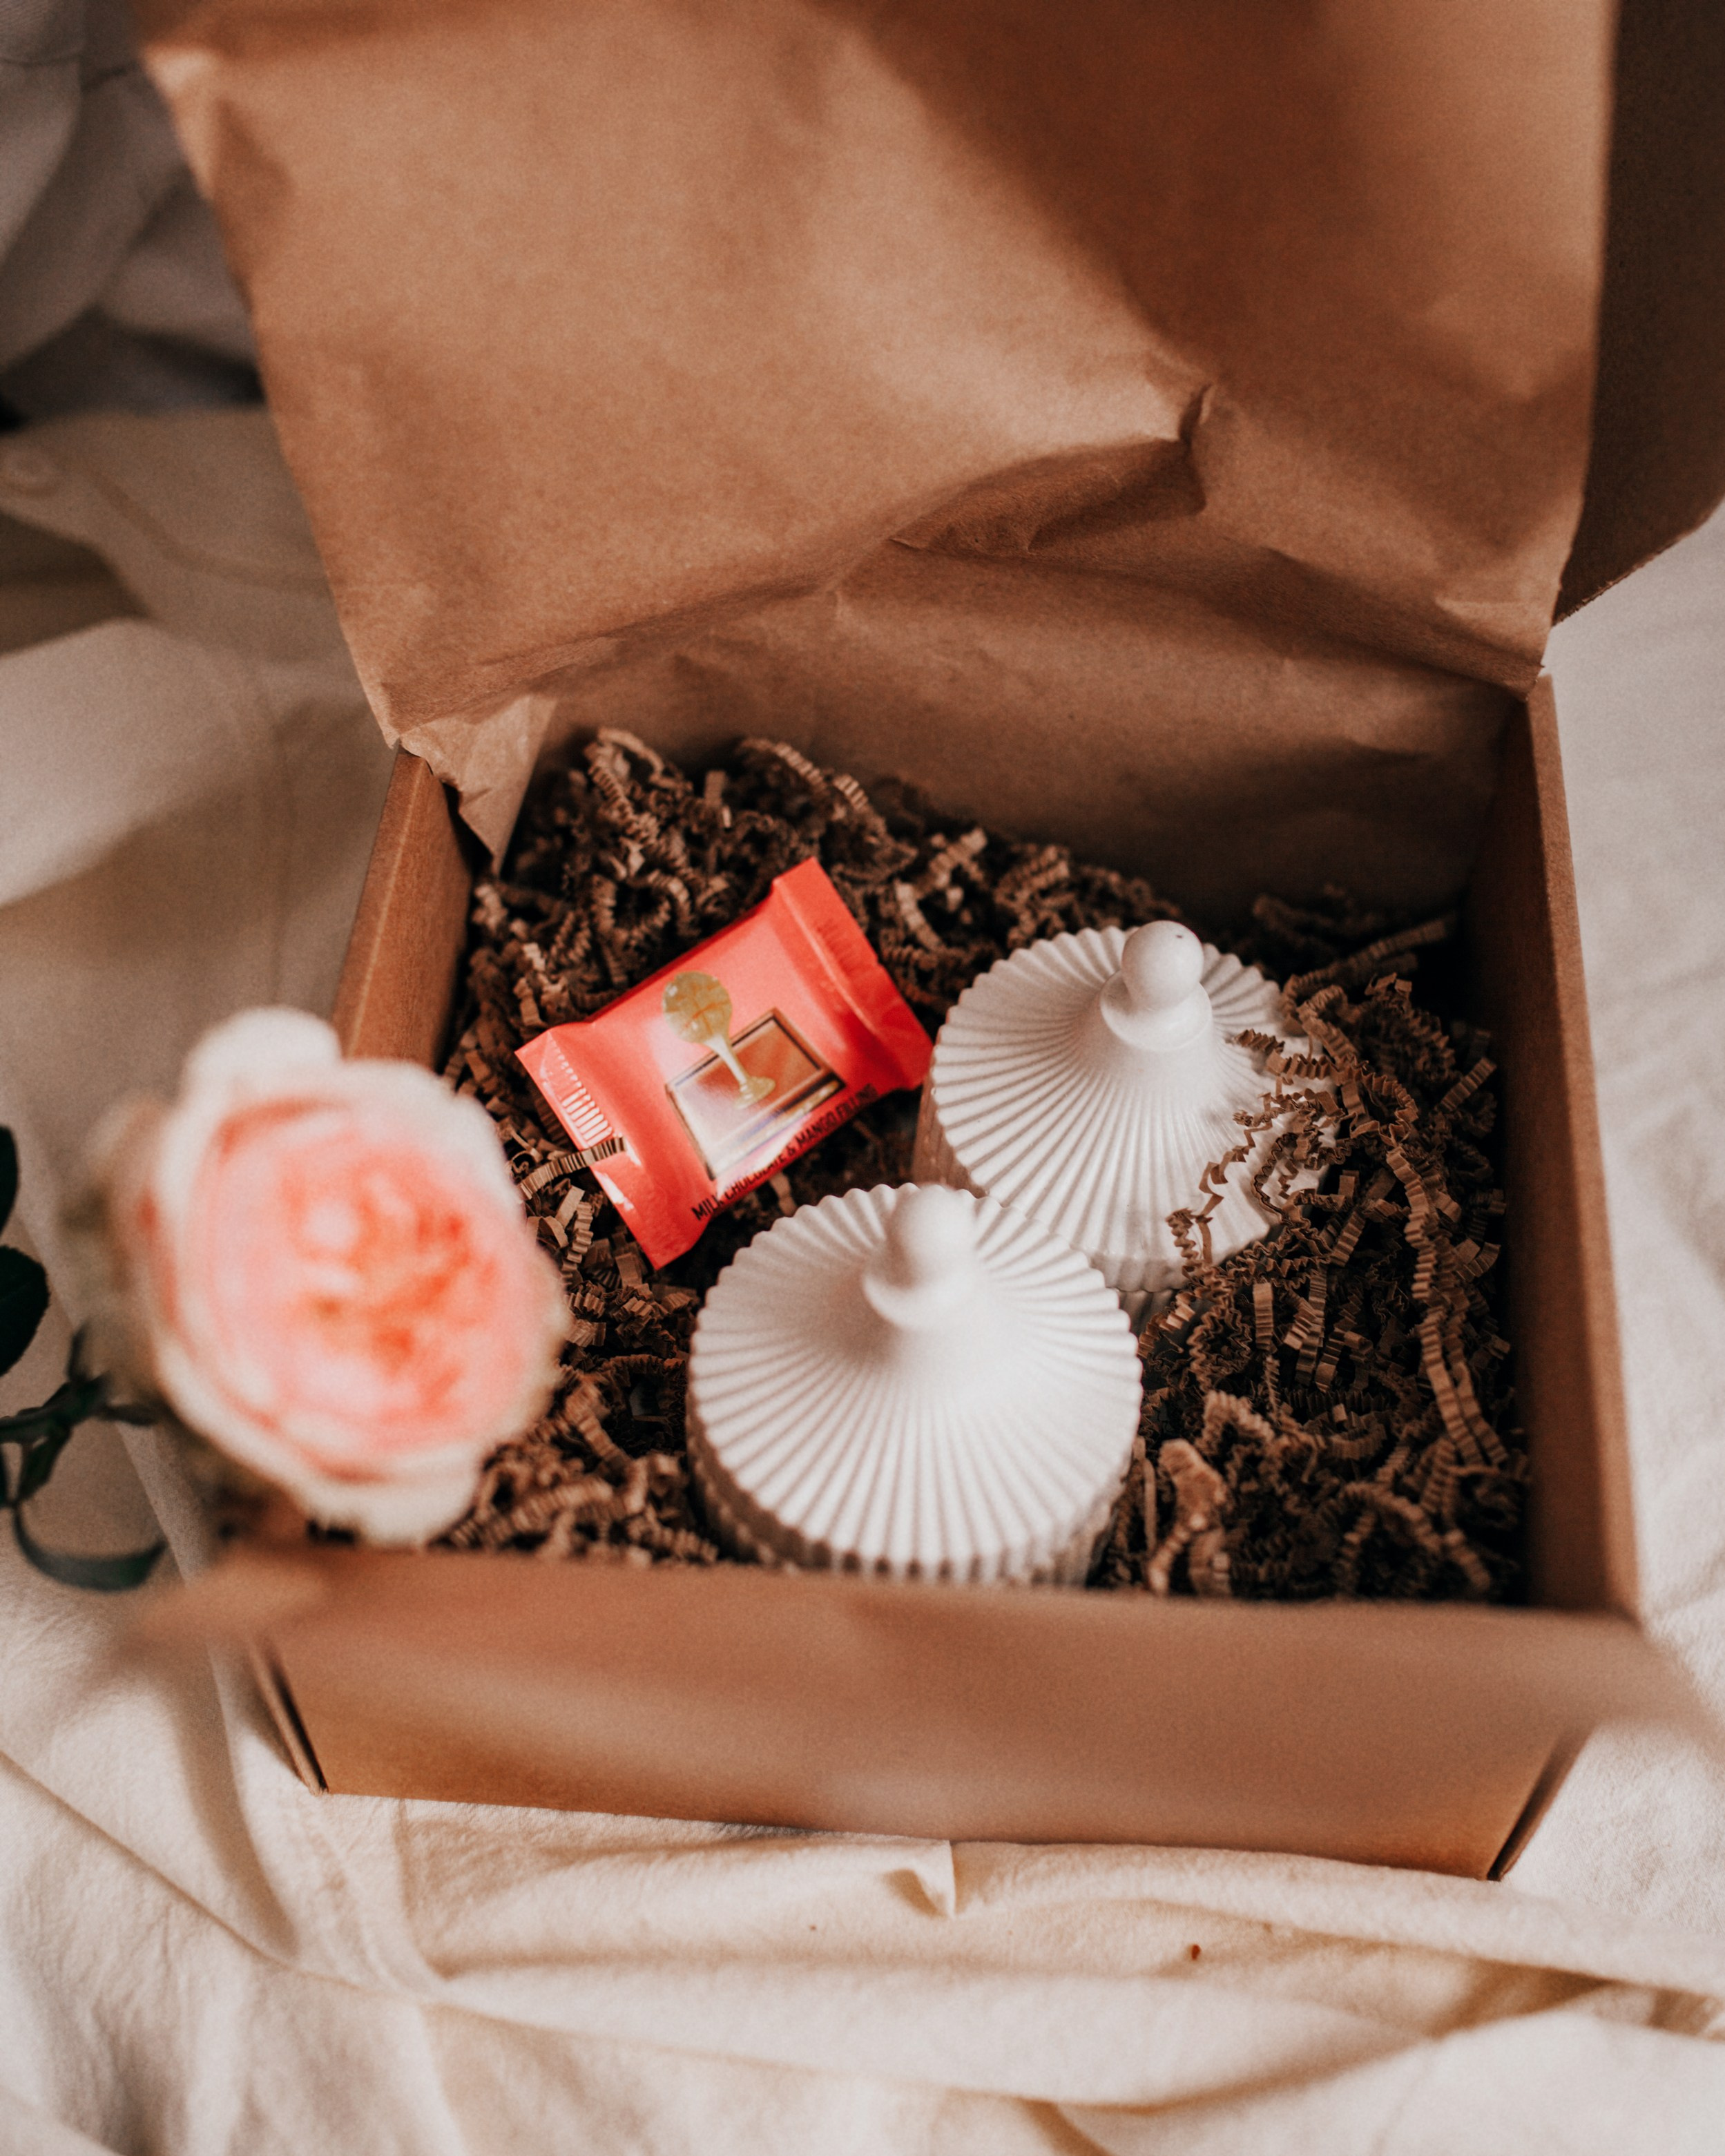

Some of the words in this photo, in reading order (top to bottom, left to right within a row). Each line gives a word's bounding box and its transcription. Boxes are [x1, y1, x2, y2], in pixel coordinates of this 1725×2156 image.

[691, 1194, 724, 1221] MILK
[786, 1144, 796, 1157] &
[795, 1111, 838, 1147] MANGO
